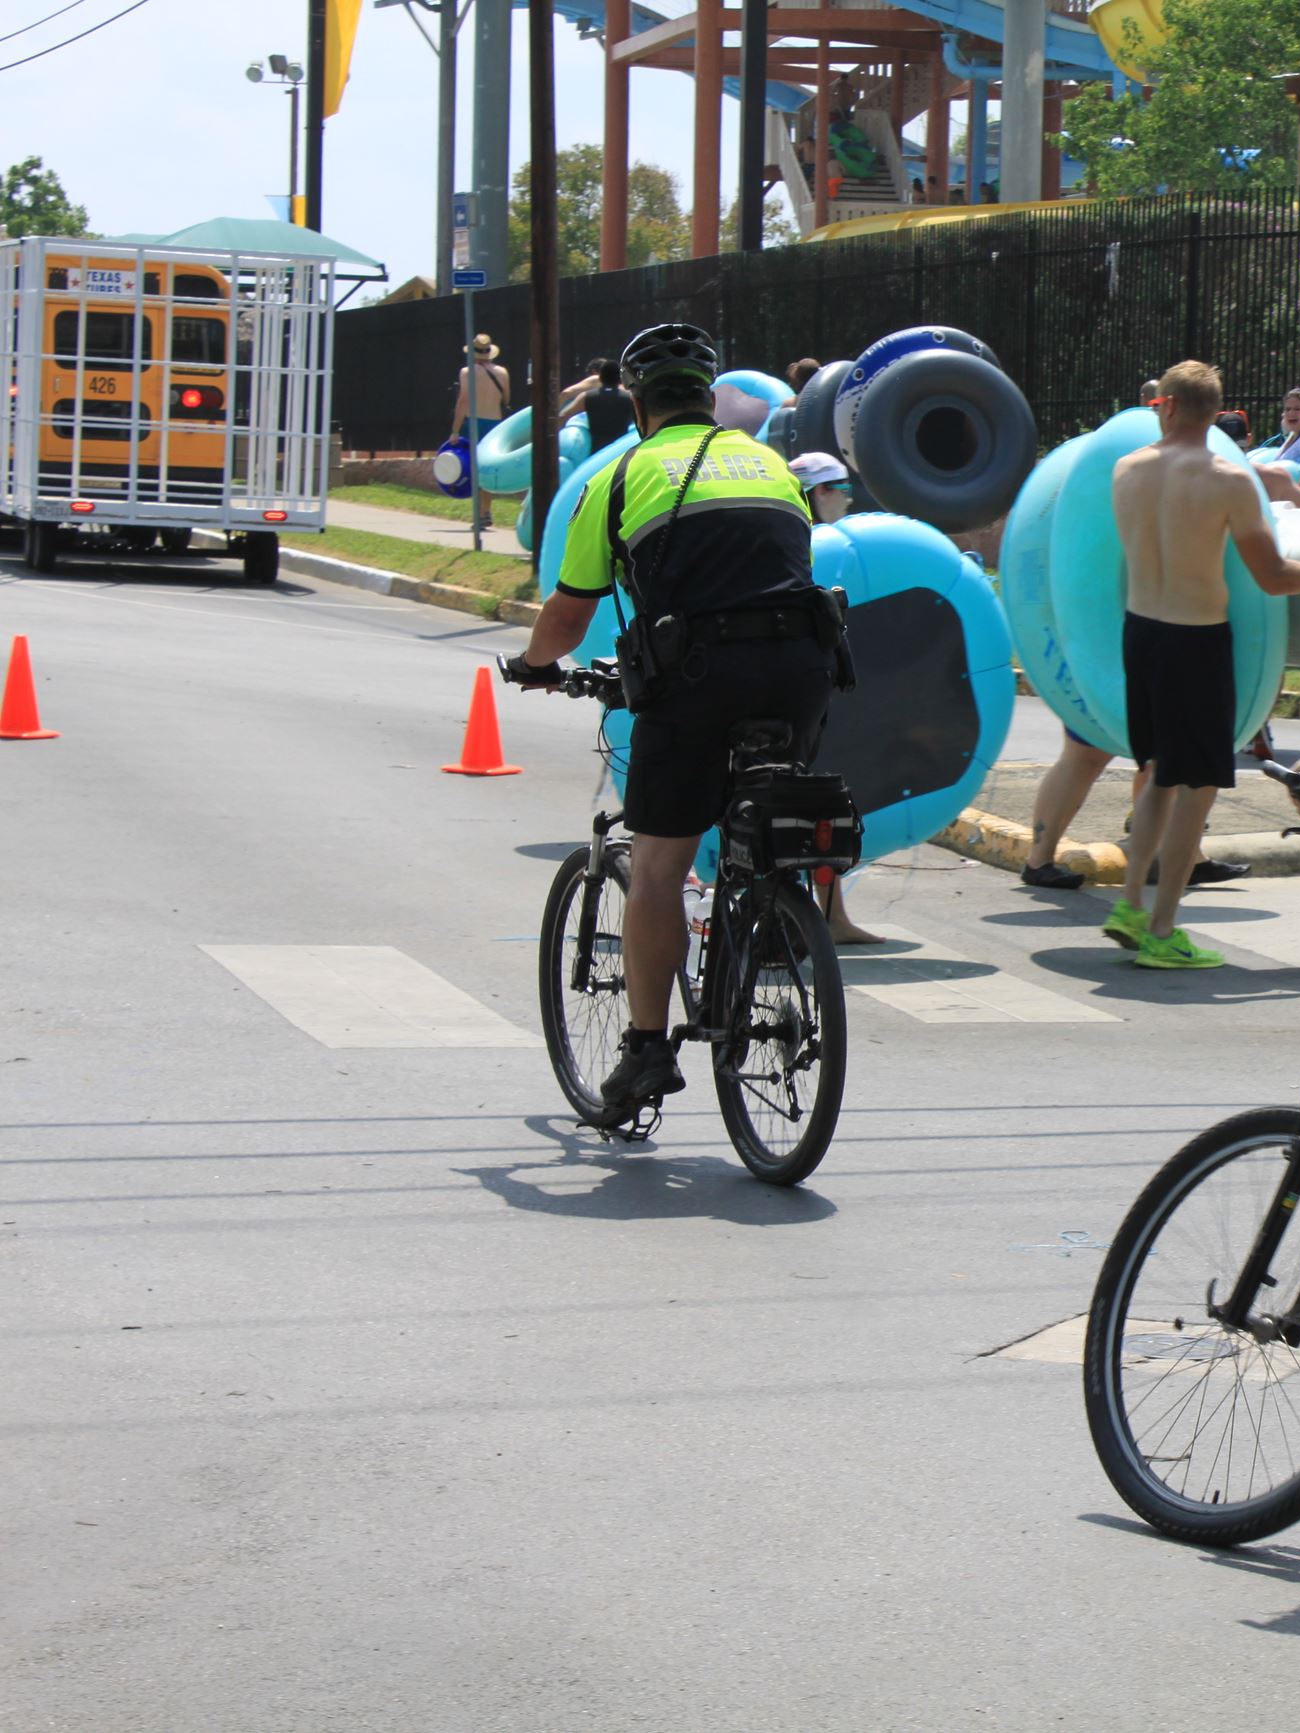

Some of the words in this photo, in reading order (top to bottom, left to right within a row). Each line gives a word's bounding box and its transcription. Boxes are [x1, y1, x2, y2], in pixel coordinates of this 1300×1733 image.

[86, 271, 122, 283] TEXAS
[89, 376, 116, 394] 426
[661, 454, 775, 487] POLICE
